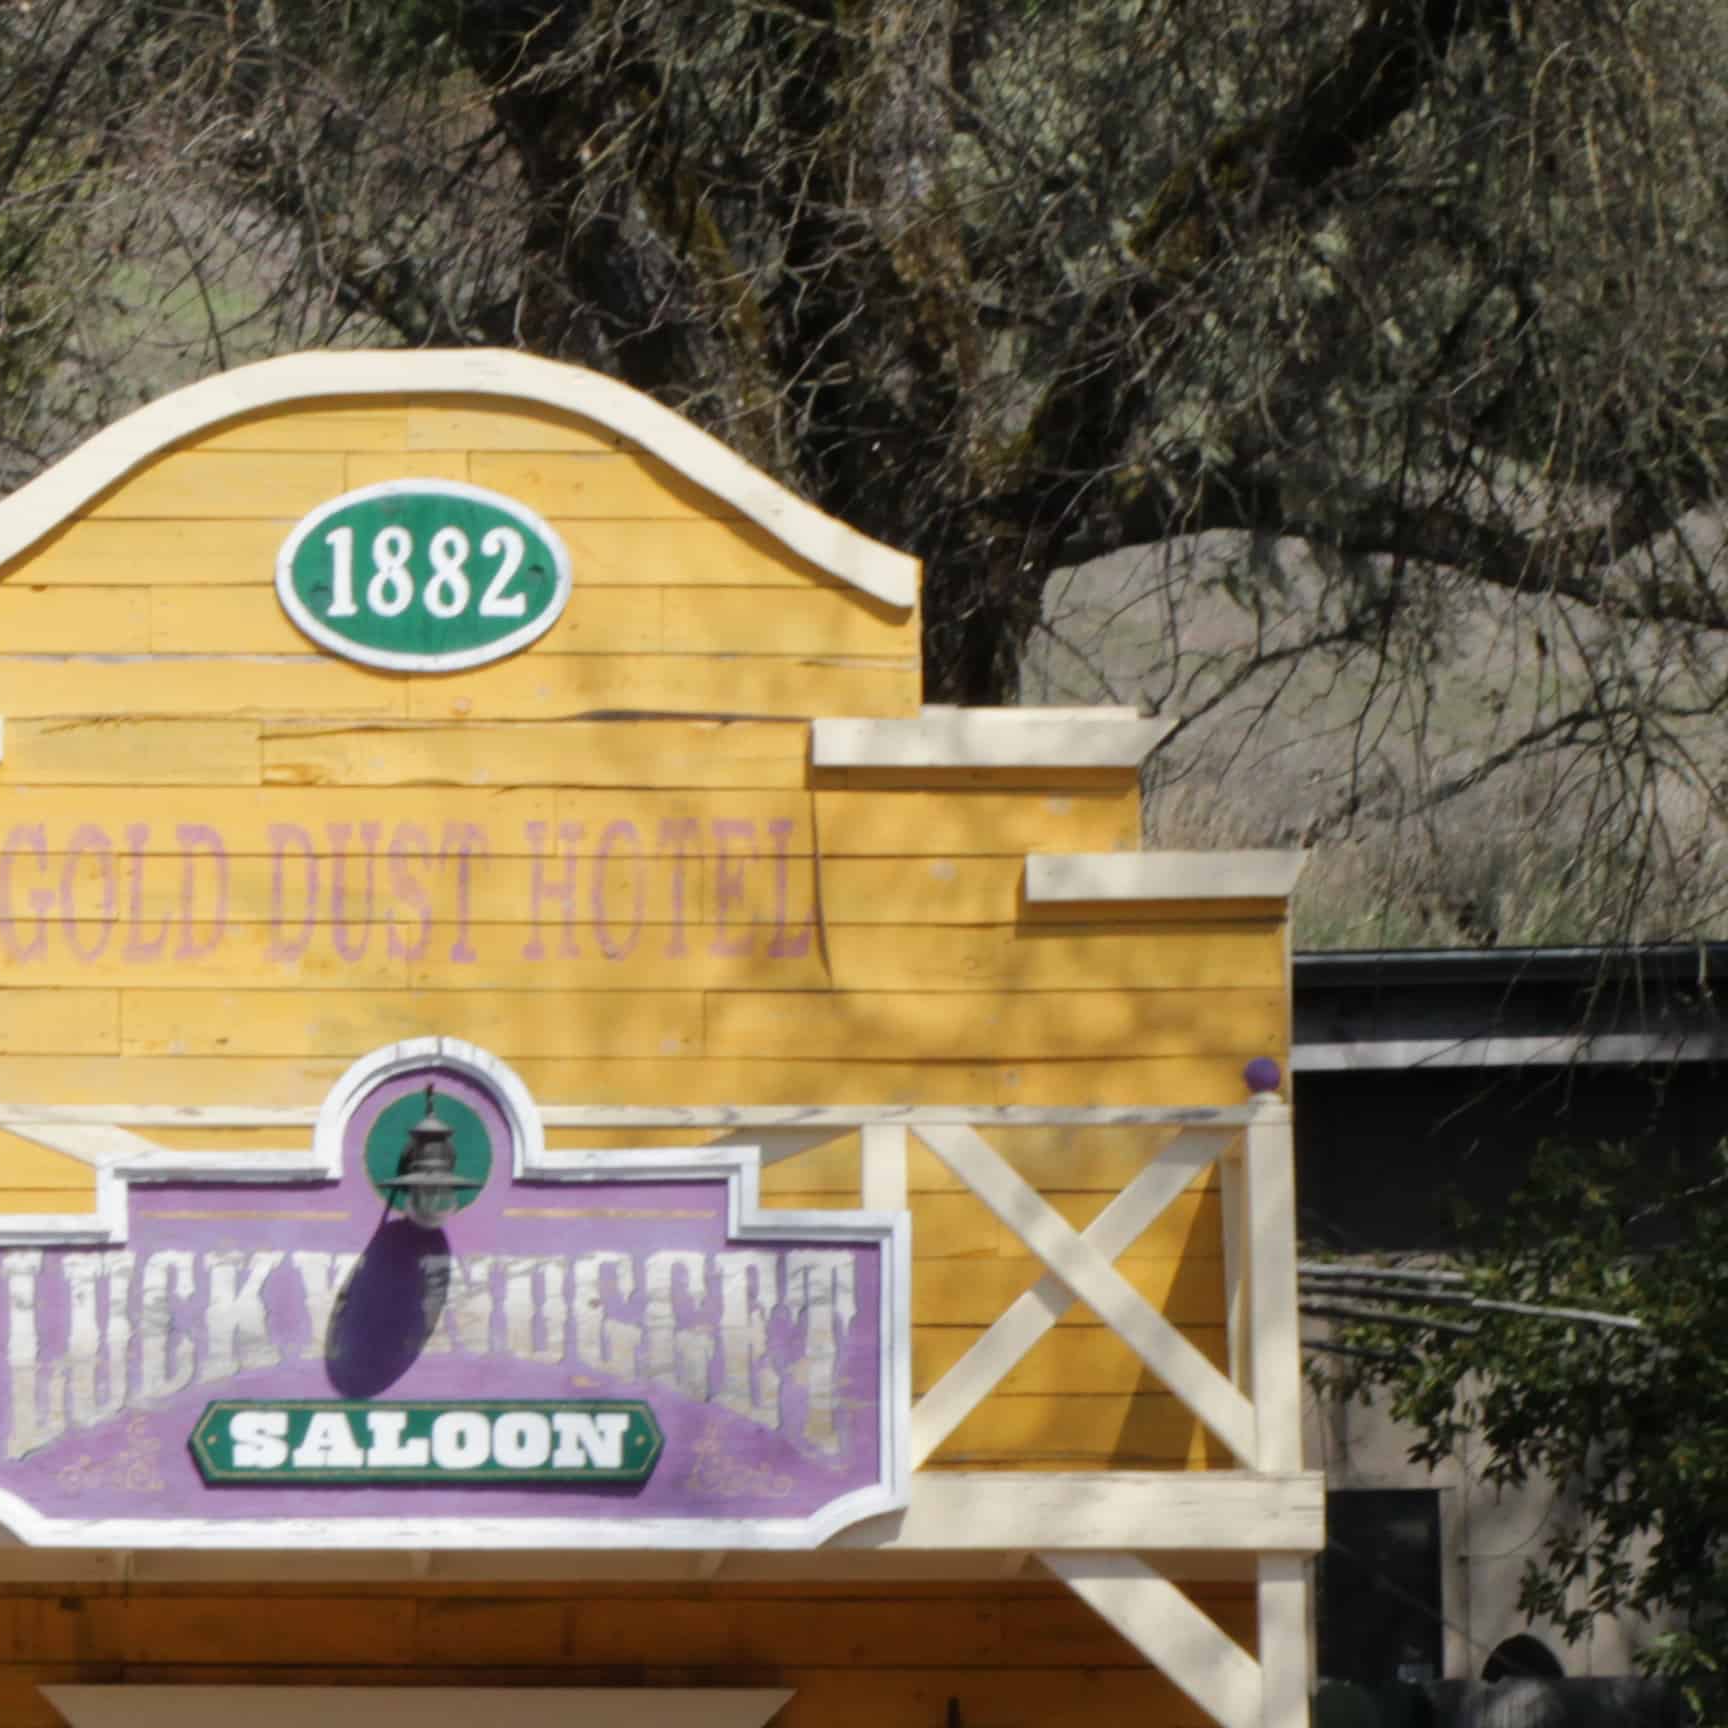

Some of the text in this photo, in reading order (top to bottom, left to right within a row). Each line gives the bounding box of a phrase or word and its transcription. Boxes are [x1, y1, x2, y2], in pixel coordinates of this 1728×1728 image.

[323, 526, 528, 620] 1882
[264, 820, 488, 964] DUST
[523, 817, 814, 962] HOTEL
[2, 1249, 857, 1461] LUCKY NUGGET
[228, 1411, 630, 1469] SALOON
